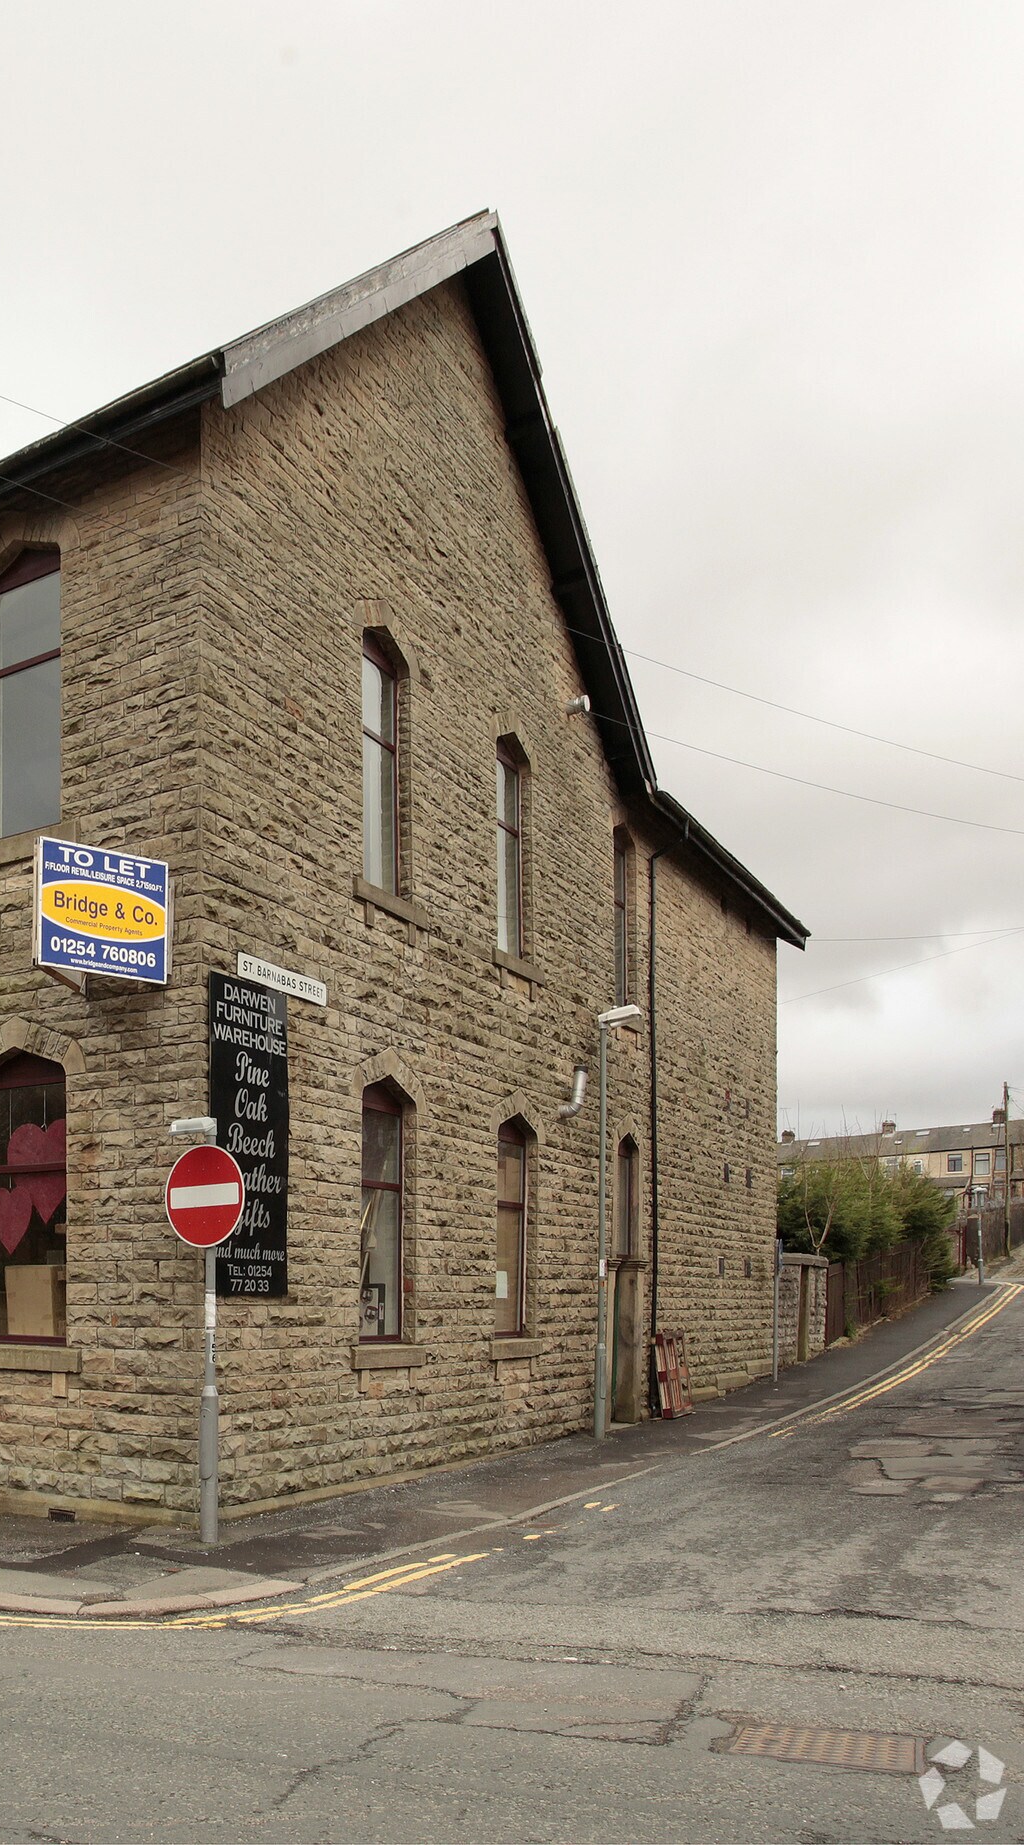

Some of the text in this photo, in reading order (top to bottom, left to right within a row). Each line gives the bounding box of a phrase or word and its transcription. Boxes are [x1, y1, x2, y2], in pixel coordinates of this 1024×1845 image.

[58, 846, 151, 879] TO LET
[116, 875, 135, 887] SPACE
[54, 890, 158, 926] Bridge & Co.
[65, 916, 143, 936] Commercial Property Agents
[50, 936, 156, 967] 01254 760806
[70, 957, 138, 974] www.bridgeandcompany.com
[242, 960, 323, 999] ST. BARNABAS STREET
[223, 982, 276, 1014] DARWEN
[216, 1001, 283, 1037] FURNITURE
[213, 1022, 287, 1057] WAREHOUSE
[235, 1051, 270, 1088] Pine
[234, 1087, 268, 1122] Oak
[226, 1122, 276, 1159] Beech
[234, 1242, 261, 1261] much
[262, 1249, 285, 1262] more
[230, 1279, 270, 1292] 77 20 33
[247, 1265, 272, 1278] 01254
